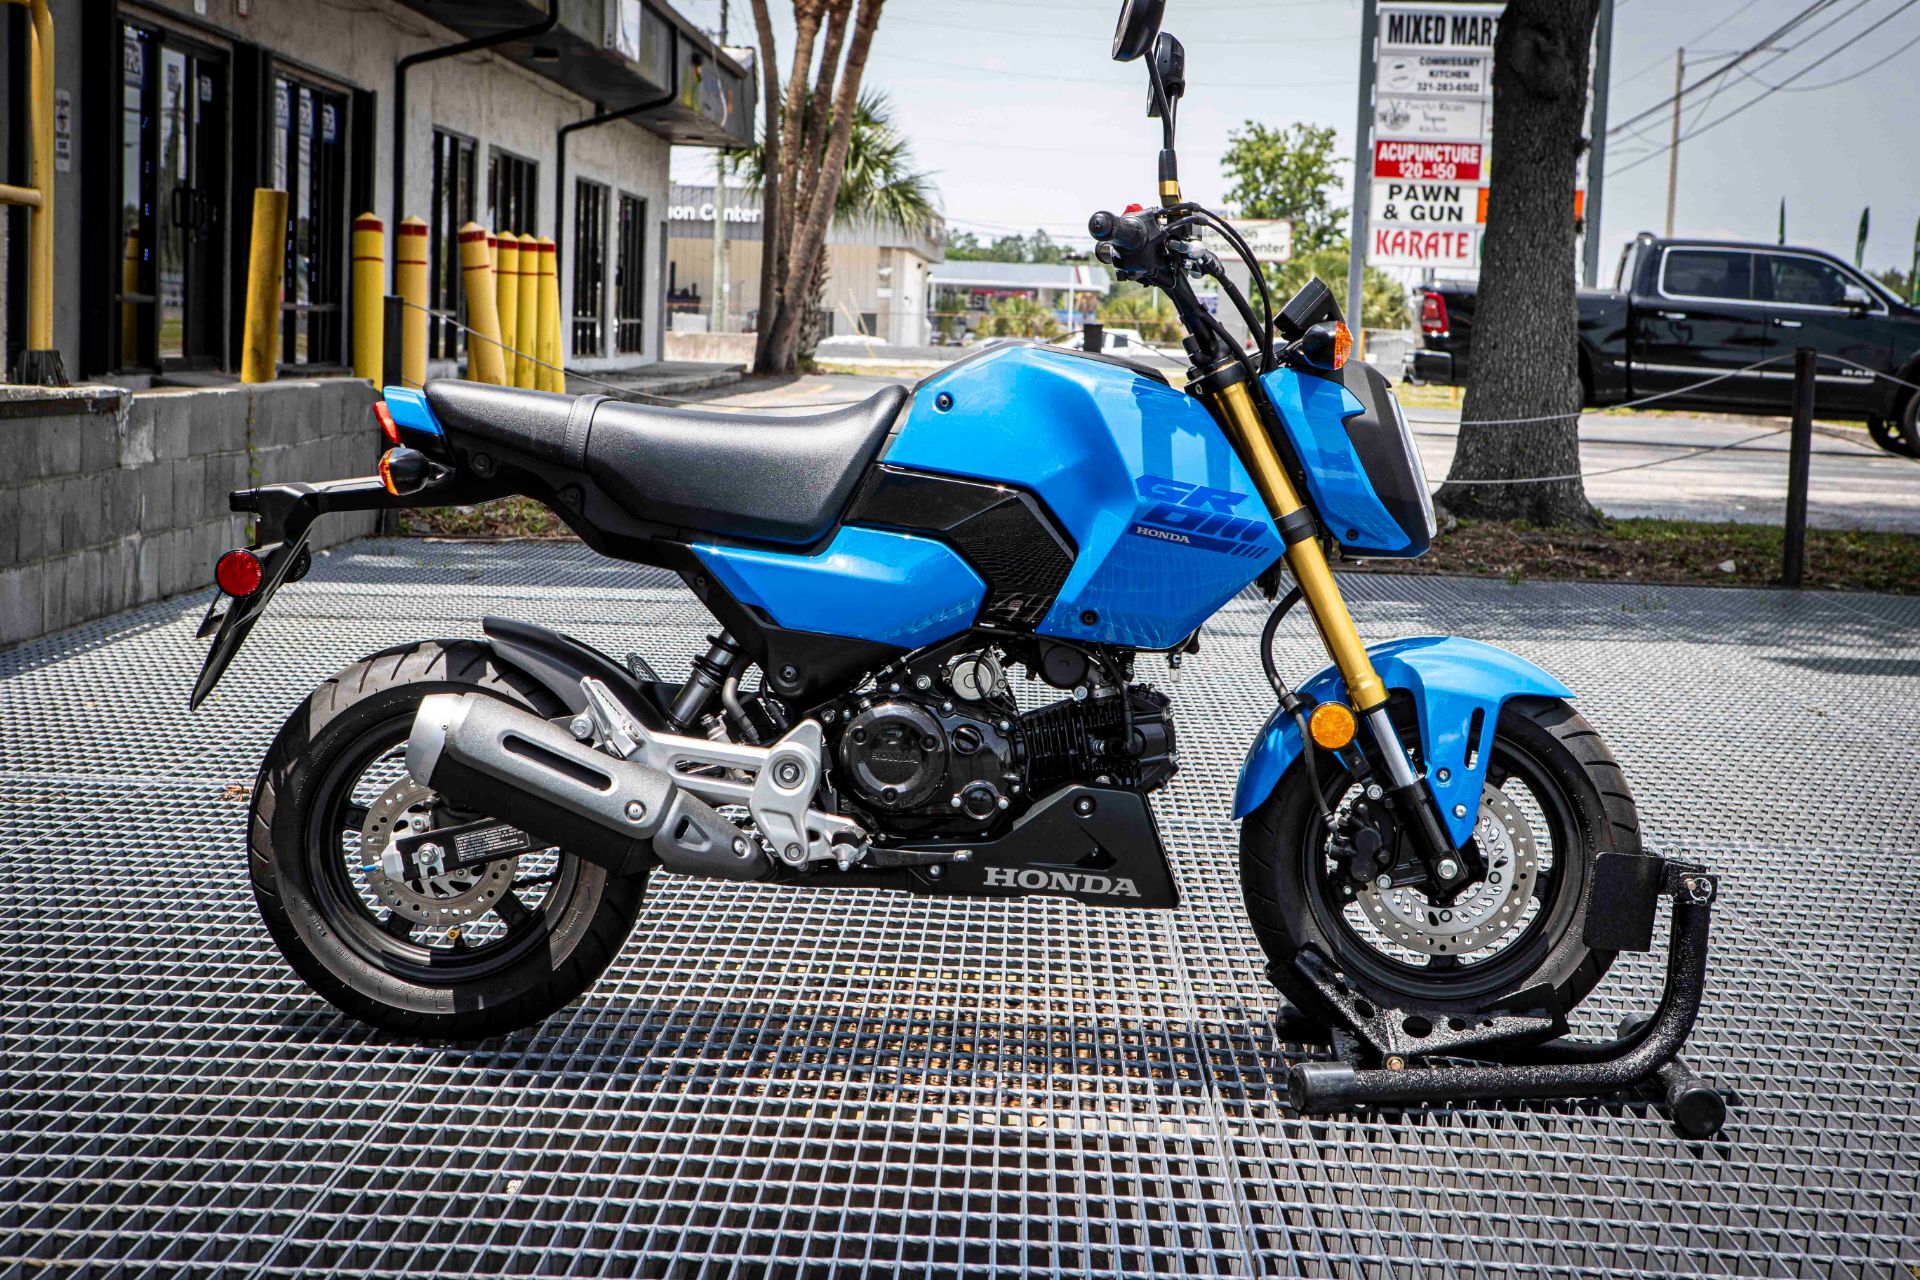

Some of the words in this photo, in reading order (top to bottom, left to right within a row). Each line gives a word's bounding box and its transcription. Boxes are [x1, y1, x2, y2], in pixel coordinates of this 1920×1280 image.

[1388, 14, 1445, 44] MIXED
[1419, 56, 1480, 67] COMMISSARY
[1429, 70, 1470, 78] KITCHEN
[1378, 143, 1479, 164] ACUPUNCTURE
[1388, 184, 1460, 202] PAWN
[1383, 204, 1399, 220] &
[1410, 205, 1463, 222] GUN
[1376, 229, 1469, 260] KARATE
[1135, 526, 1191, 544] HONDA
[983, 866, 1142, 898] HONDA
